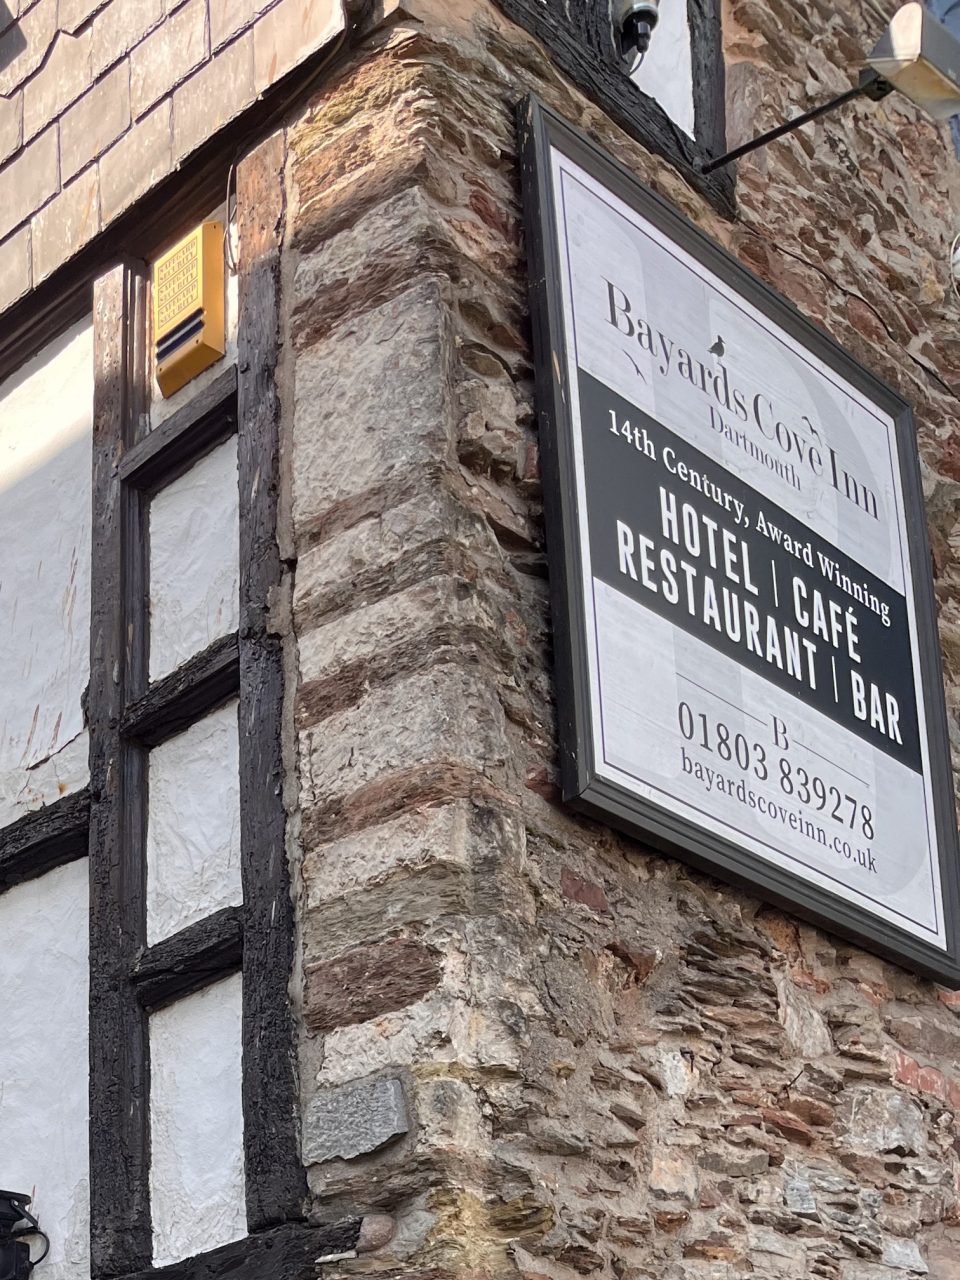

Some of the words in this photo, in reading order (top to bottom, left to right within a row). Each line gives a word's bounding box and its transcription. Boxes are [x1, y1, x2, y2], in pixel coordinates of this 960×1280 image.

[600, 275, 748, 422] Bayards
[753, 393, 823, 476] Cove
[826, 441, 880, 521] Inn
[709, 406, 801, 491] Dartmouth
[608, 409, 657, 462] 14th
[663, 447, 750, 528] Century,
[756, 510, 814, 568] Award
[817, 551, 891, 627] Winning
[659, 486, 759, 596] HOTEL
[793, 575, 861, 664] CAFÉ
[616, 519, 817, 690] RESTAURANT
[850, 669, 903, 746] BAR
[678, 701, 768, 781] 01803
[779, 757, 874, 841] 839278
[680, 747, 878, 874] bayardscoveinn.co.uk
[769, 713, 790, 751] B
